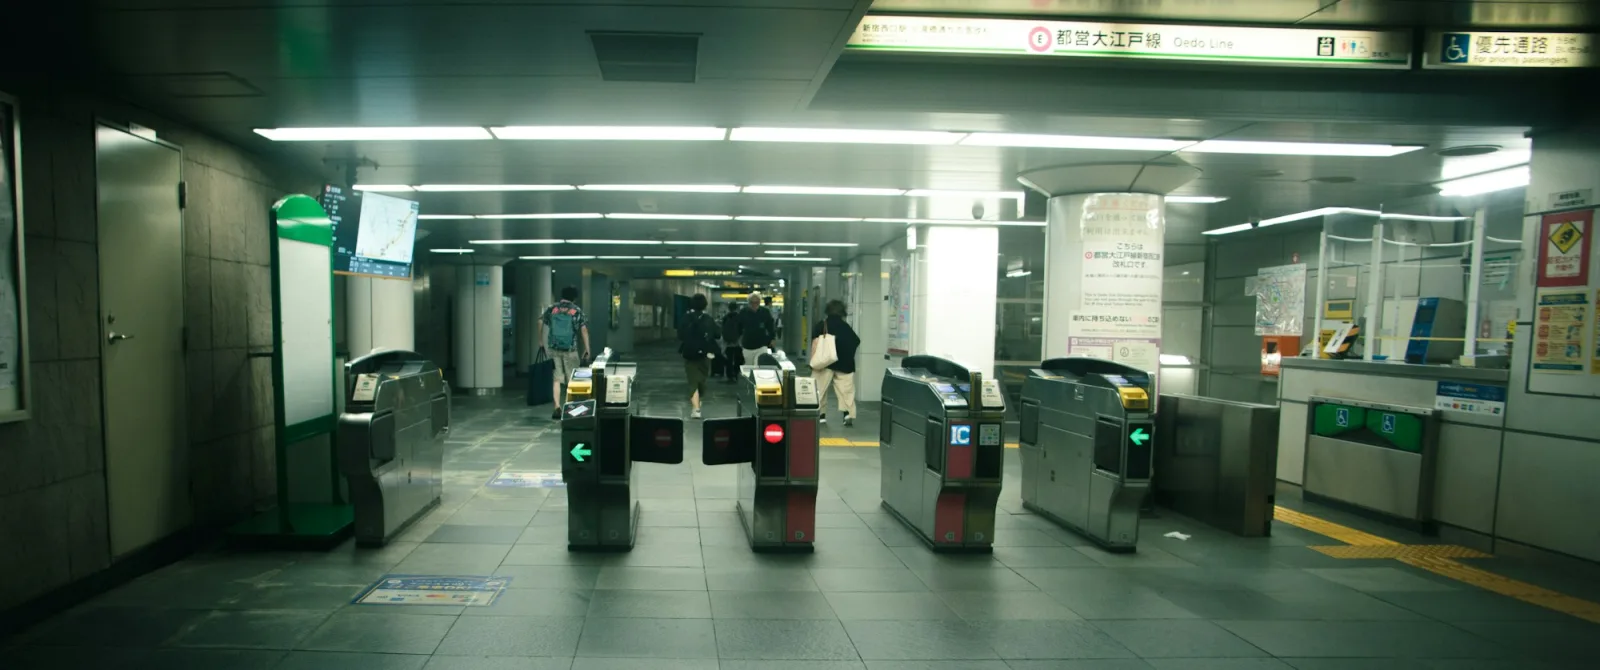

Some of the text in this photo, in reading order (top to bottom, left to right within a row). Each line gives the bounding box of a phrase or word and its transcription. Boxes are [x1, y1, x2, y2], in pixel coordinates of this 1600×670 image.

[1056, 29, 1162, 49] 都営大江戸線
[1173, 36, 1233, 50] Oedo Line
[1475, 35, 1548, 54] 優先通路
[1473, 55, 1568, 65] For priority passengers
[951, 426, 970, 444] IC
